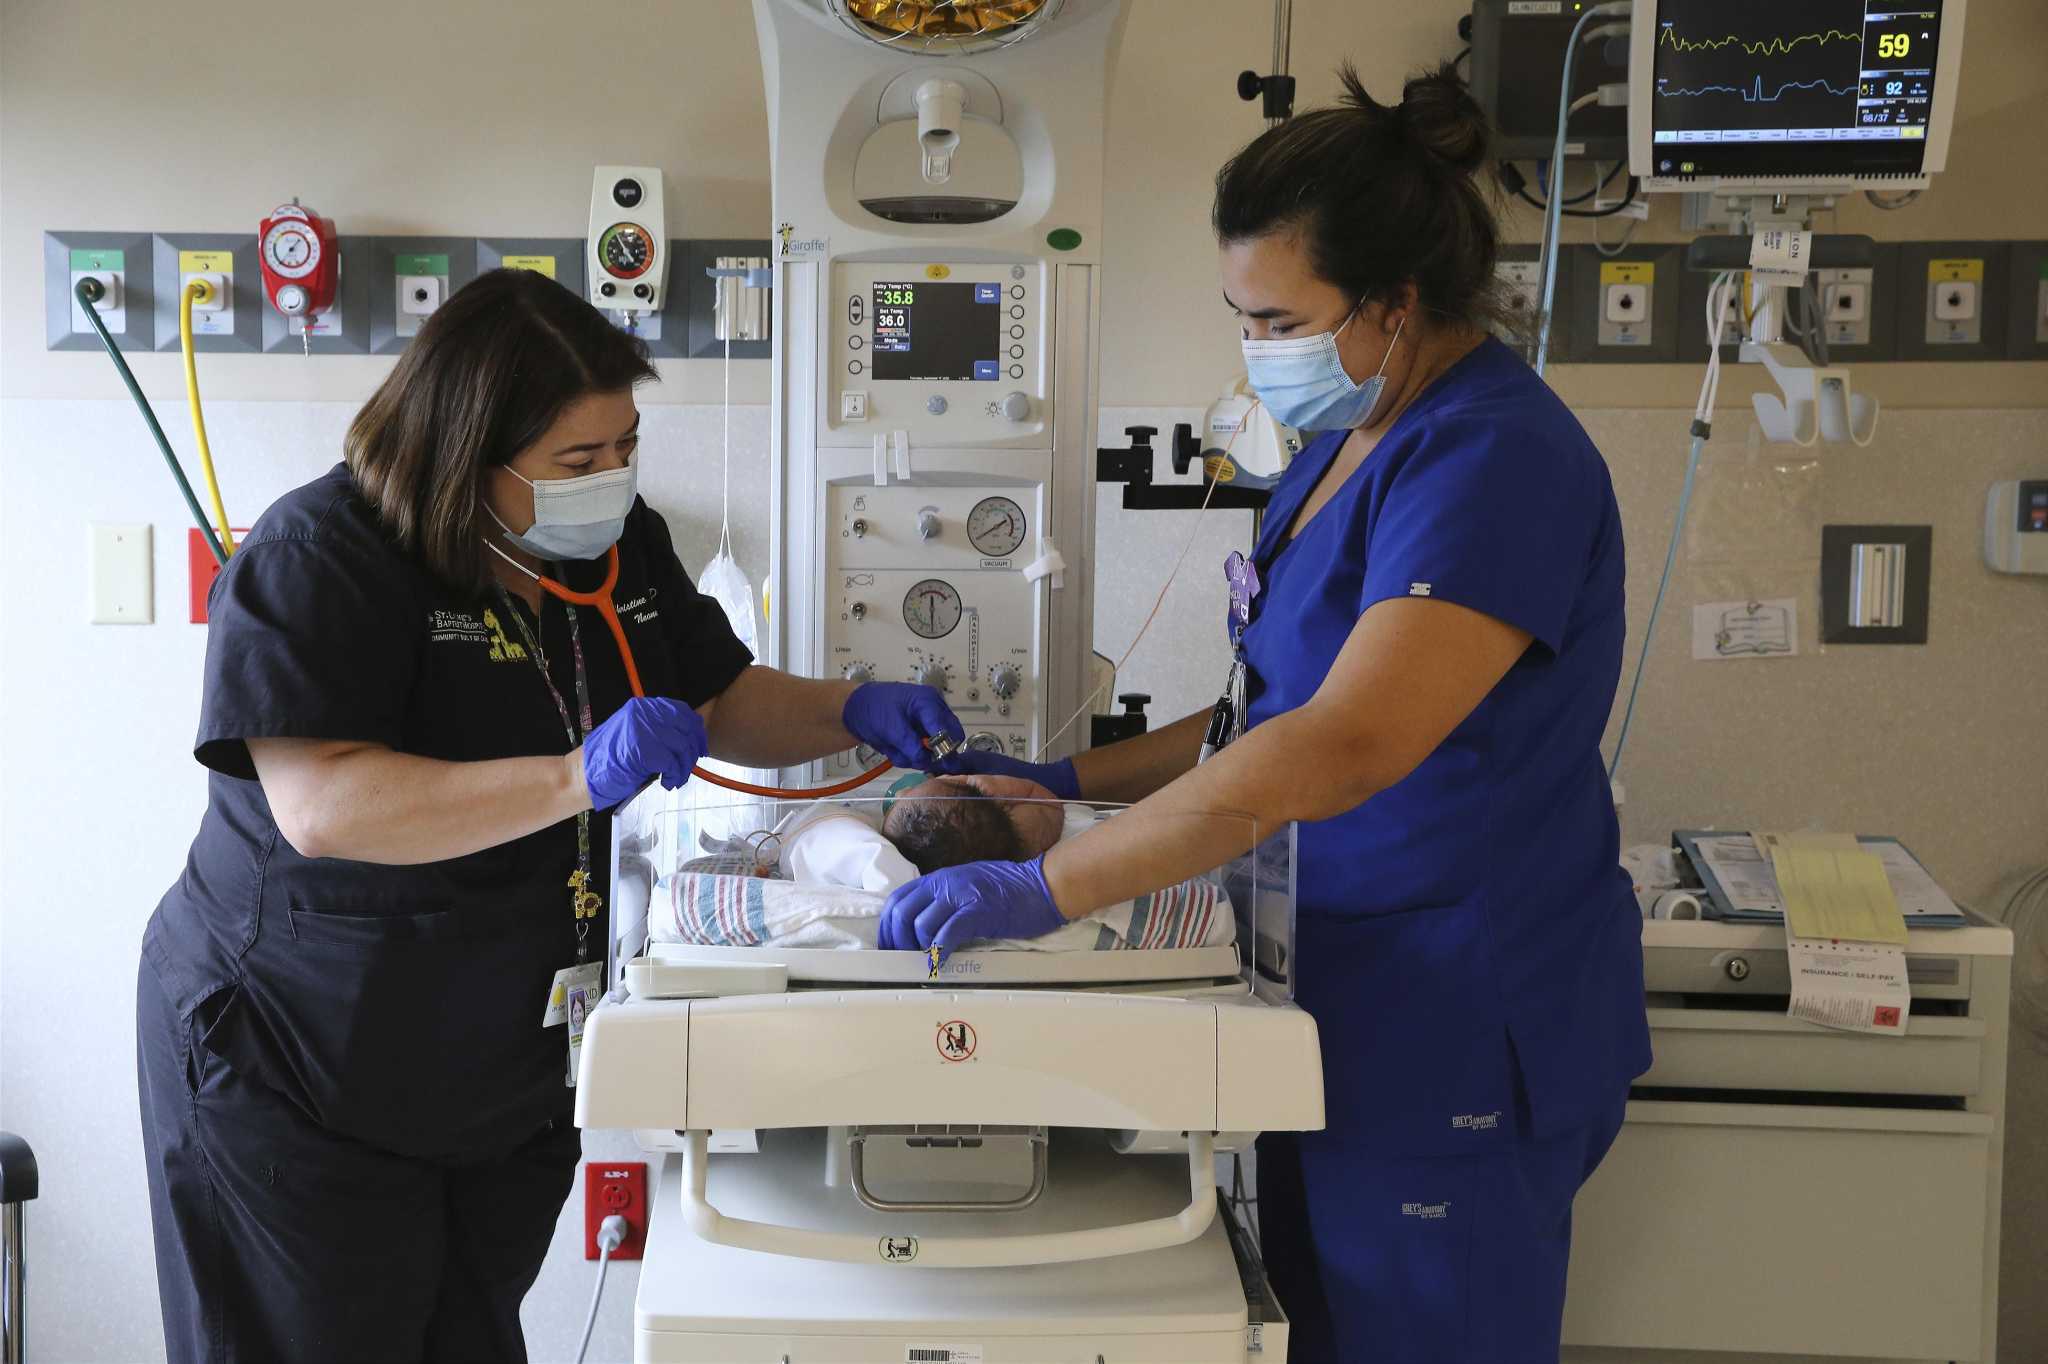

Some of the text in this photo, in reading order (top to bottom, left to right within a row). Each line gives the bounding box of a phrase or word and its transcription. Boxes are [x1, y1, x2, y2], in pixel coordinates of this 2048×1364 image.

[1878, 33, 1910, 58] 59
[1886, 81, 1902, 95] 92
[790, 239, 825, 251] Giraffe
[883, 291, 914, 305] 35.8
[879, 315, 905, 327] 36.0
[616, 597, 647, 614] hristine
[970, 615, 978, 671] MANOMETER
[1800, 967, 1850, 978] INSURANCE
